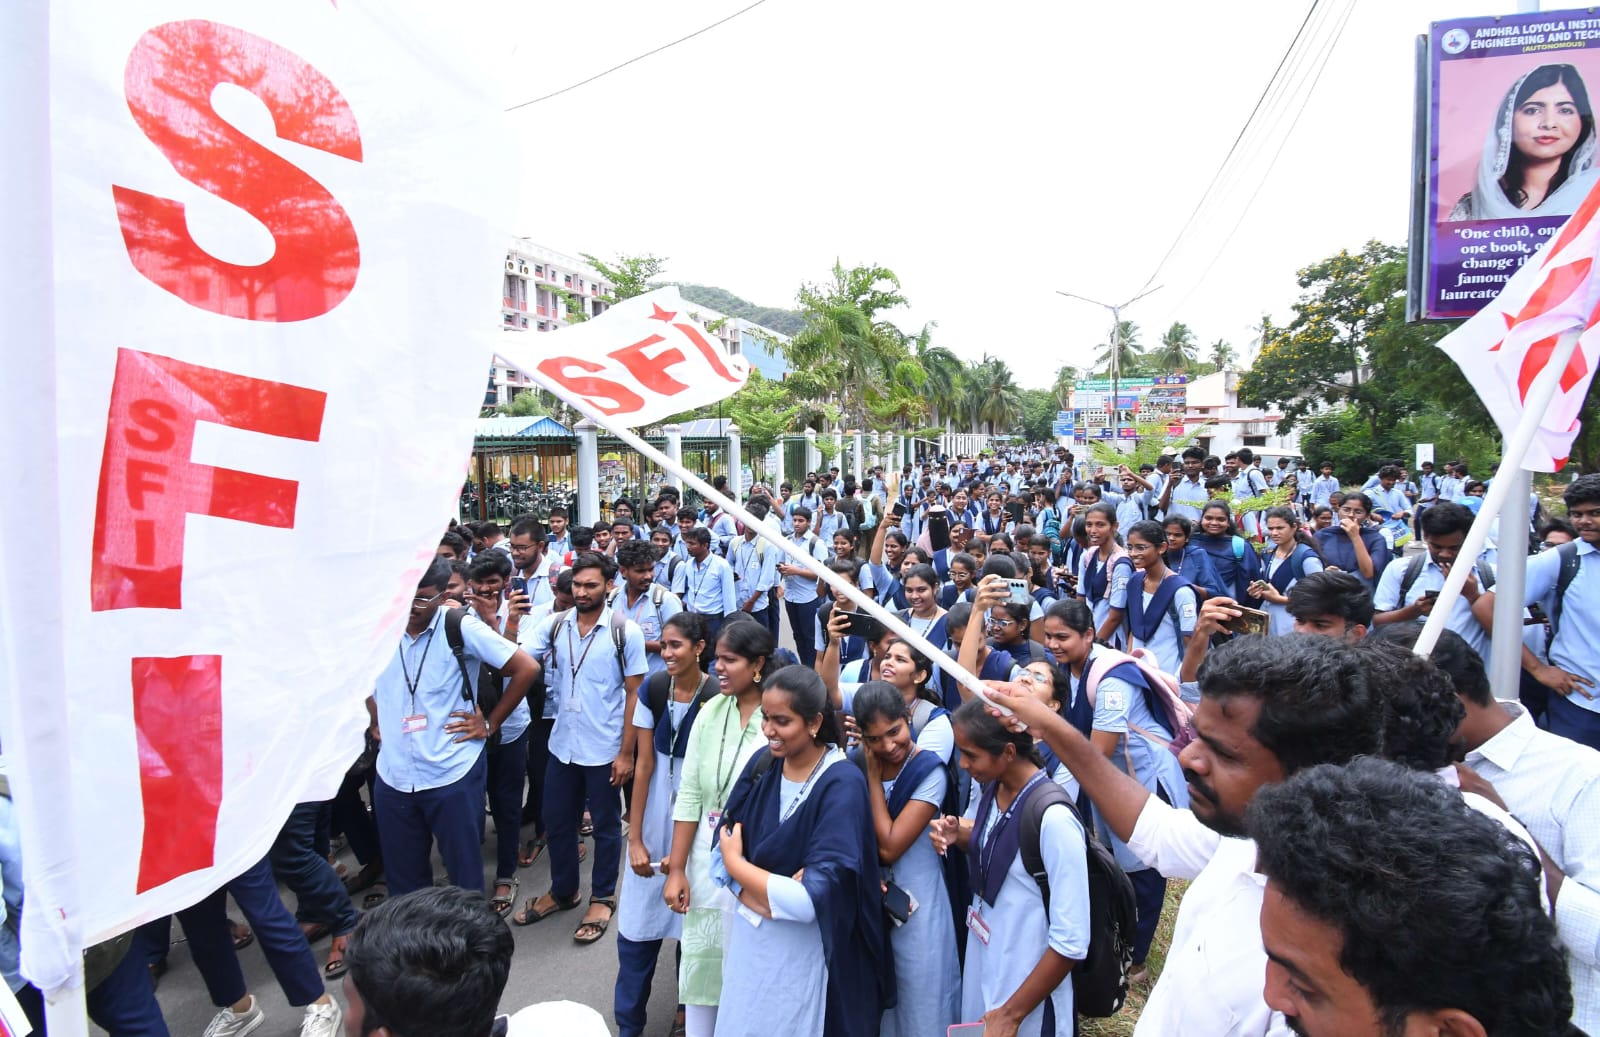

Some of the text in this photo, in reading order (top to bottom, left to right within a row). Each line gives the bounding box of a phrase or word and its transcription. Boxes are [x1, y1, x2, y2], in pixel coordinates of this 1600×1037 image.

[1475, 26, 1520, 38] ANDHRA
[1522, 21, 1565, 35] LOYOLA
[1470, 35, 1545, 50] ENGINEERING
[1548, 31, 1571, 43] AND
[1522, 41, 1586, 53] (AUTONOMOUS)
[1454, 227, 1491, 240] "One
[1493, 225, 1534, 238] child,
[1460, 244, 1487, 255] one
[1462, 257, 1514, 270] change
[1454, 272, 1510, 288] famous
[1440, 288, 1499, 301] laureate
[536, 323, 742, 416] SFI
[91, 19, 363, 895] SFI
[124, 398, 178, 566] SFI
